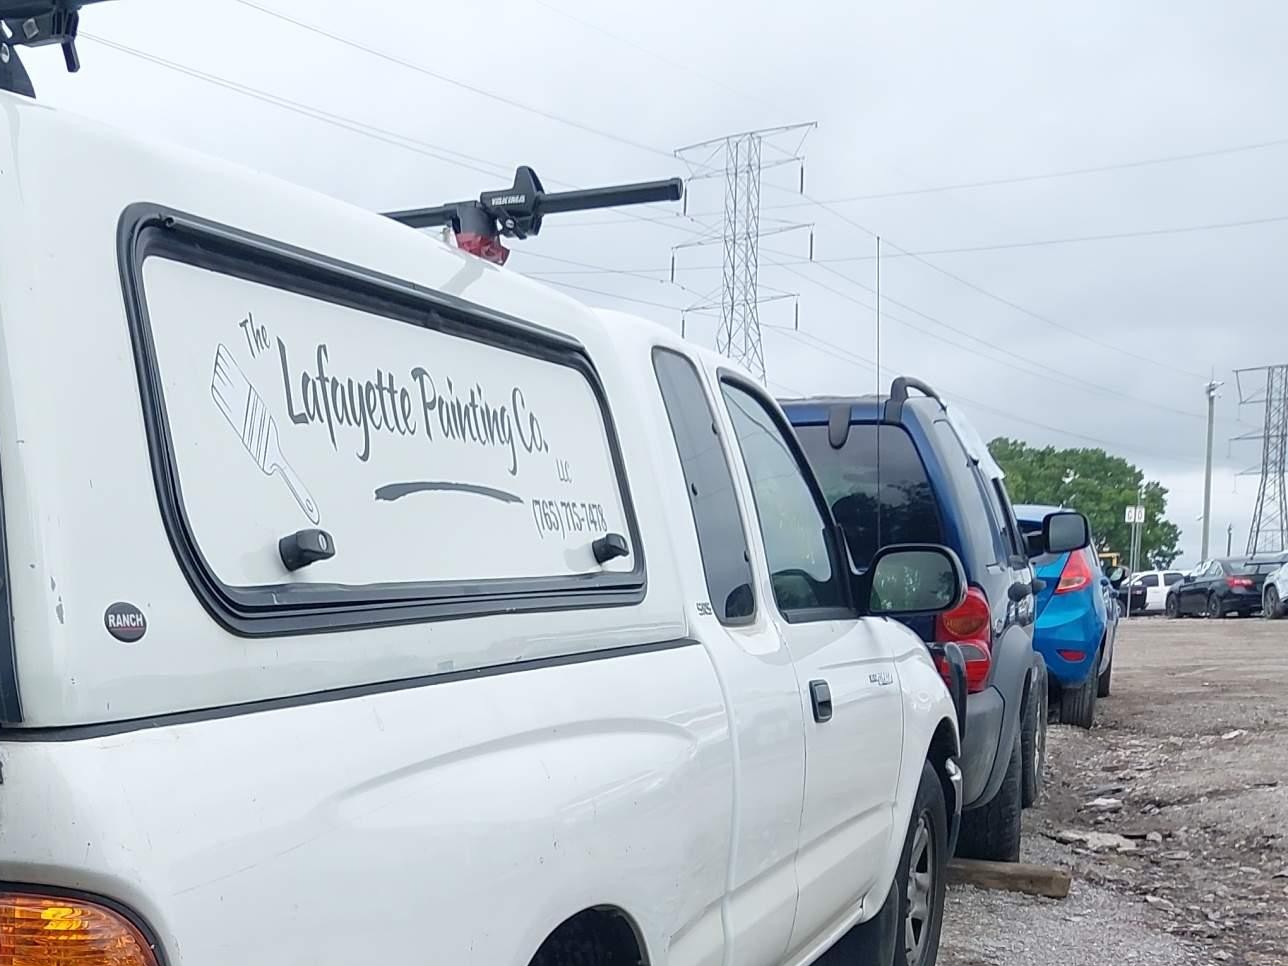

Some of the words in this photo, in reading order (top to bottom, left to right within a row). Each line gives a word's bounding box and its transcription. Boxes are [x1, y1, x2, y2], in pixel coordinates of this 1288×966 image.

[240, 312, 271, 359] The
[277, 336, 416, 462] Lafayette
[411, 366, 518, 476] Painting
[511, 387, 549, 453] Co.
[555, 457, 573, 483] LLC
[532, 499, 565, 541] (765)
[560, 501, 608, 532] 715-7478
[108, 613, 144, 628] RANCH
